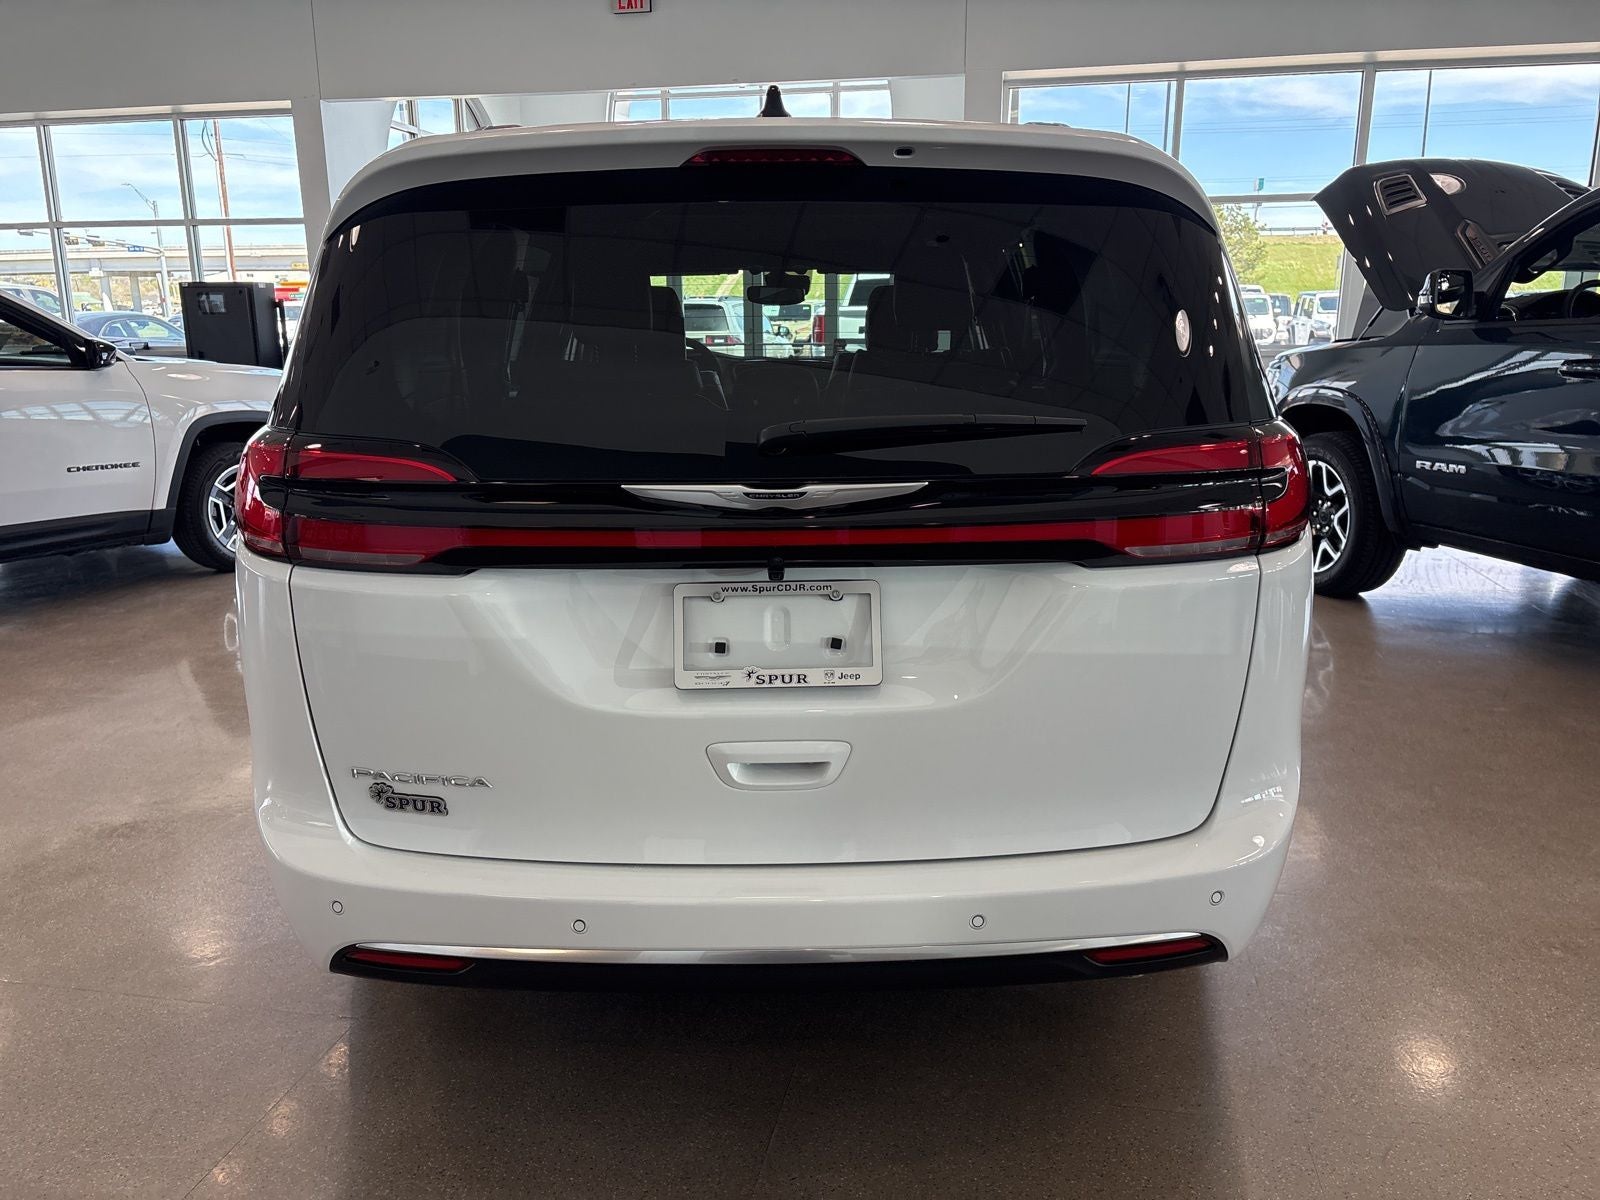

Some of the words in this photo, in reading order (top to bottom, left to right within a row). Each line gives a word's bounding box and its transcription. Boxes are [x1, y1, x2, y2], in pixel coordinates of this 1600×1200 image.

[618, 0, 645, 10] EXIT
[66, 462, 141, 473] CHEROKEE
[1415, 460, 1467, 475] RAM
[720, 583, 833, 595] www.SpurCDJR.com
[755, 673, 809, 686] SPUR
[837, 672, 861, 681] Jeep
[351, 767, 494, 788] PACIFICA
[384, 796, 444, 814] SPUR
